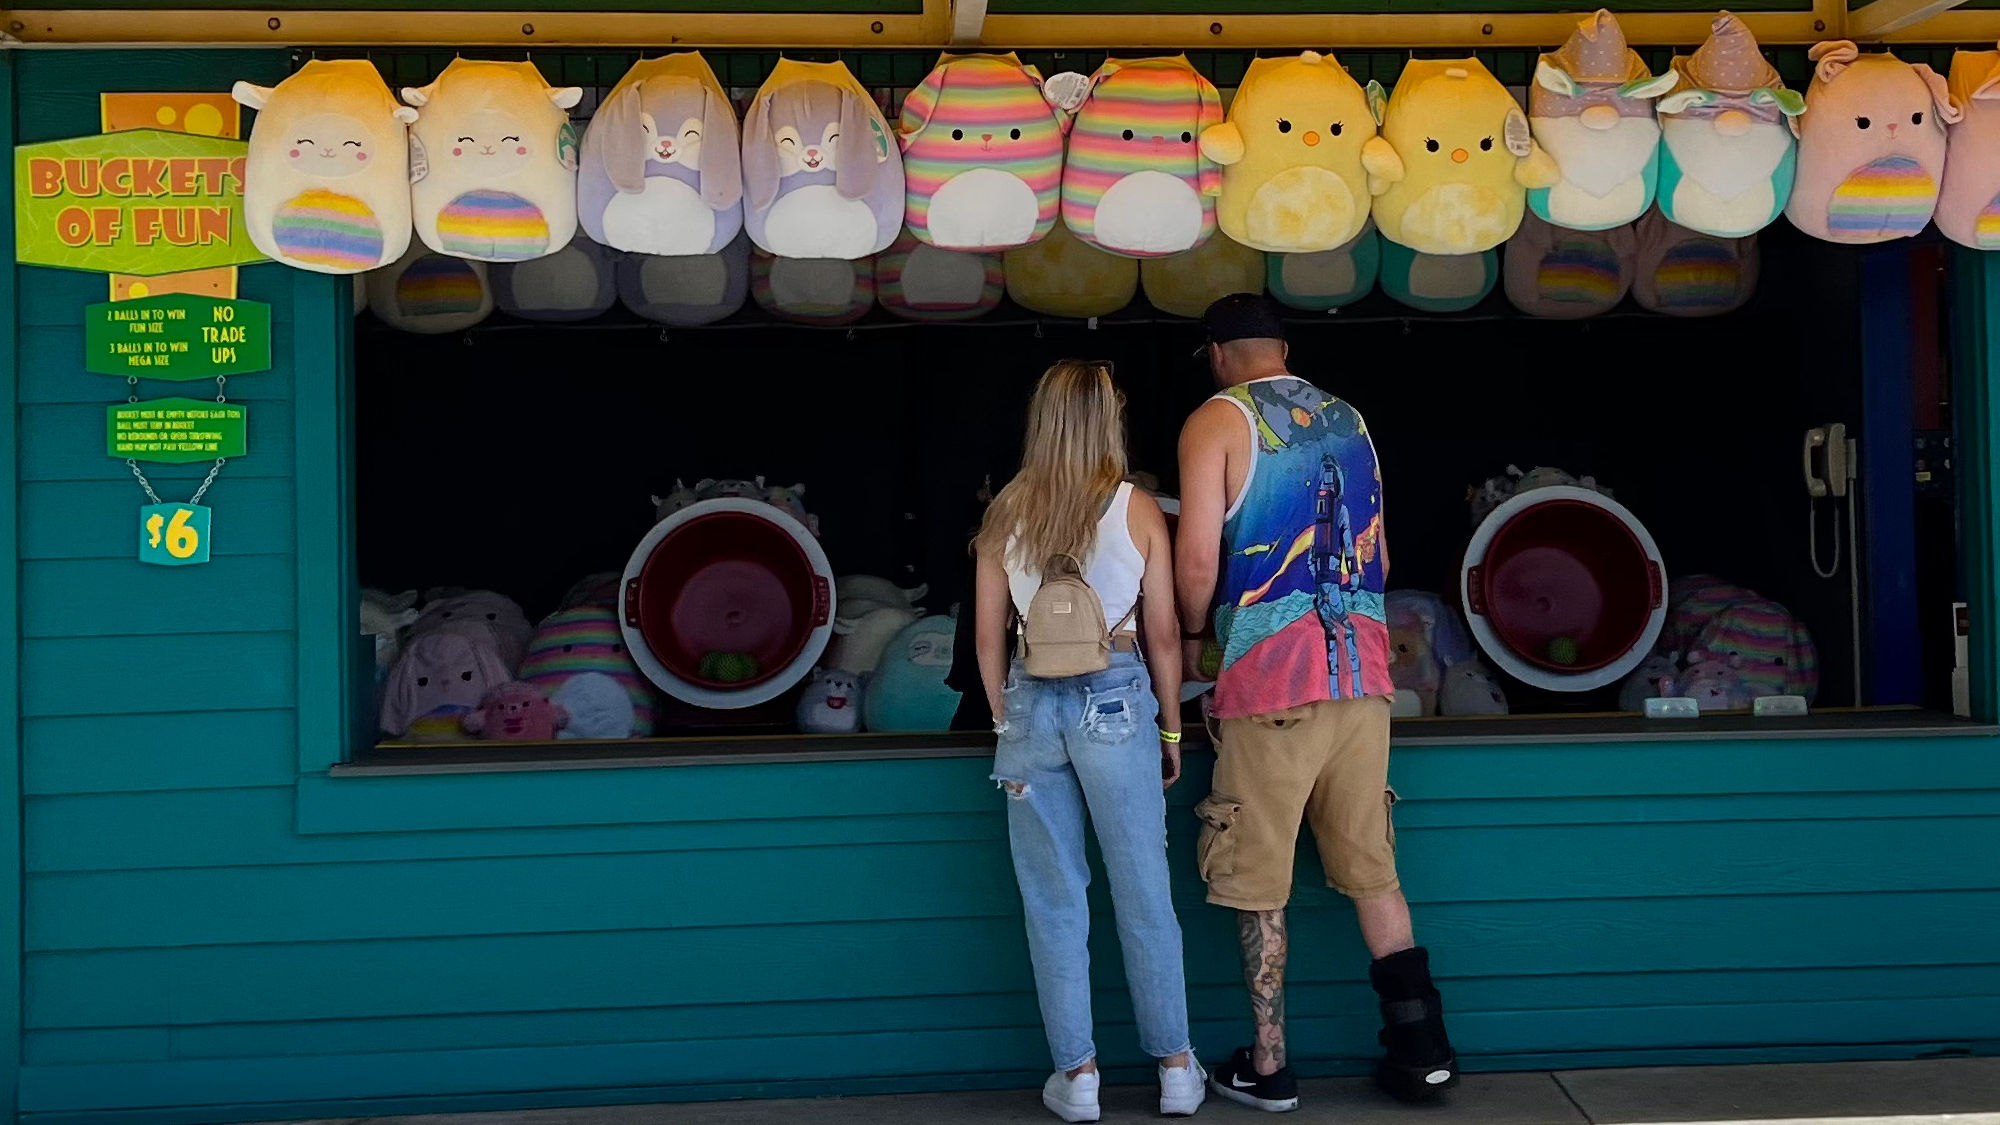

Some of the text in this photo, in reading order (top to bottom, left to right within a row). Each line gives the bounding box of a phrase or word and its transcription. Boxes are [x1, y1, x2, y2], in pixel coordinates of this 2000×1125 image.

[56, 206, 231, 247] OF FUN
[107, 309, 186, 321] 2 BALLS IN TO WIN
[213, 306, 234, 323] NO
[129, 322, 164, 333] FUN SIZE
[202, 326, 246, 343] TRADE
[110, 342, 189, 354] 3 BALLS IN TO WIN
[212, 347, 237, 364] UPS
[129, 354, 169, 366] MEGA SIZE
[146, 508, 199, 558] $6
